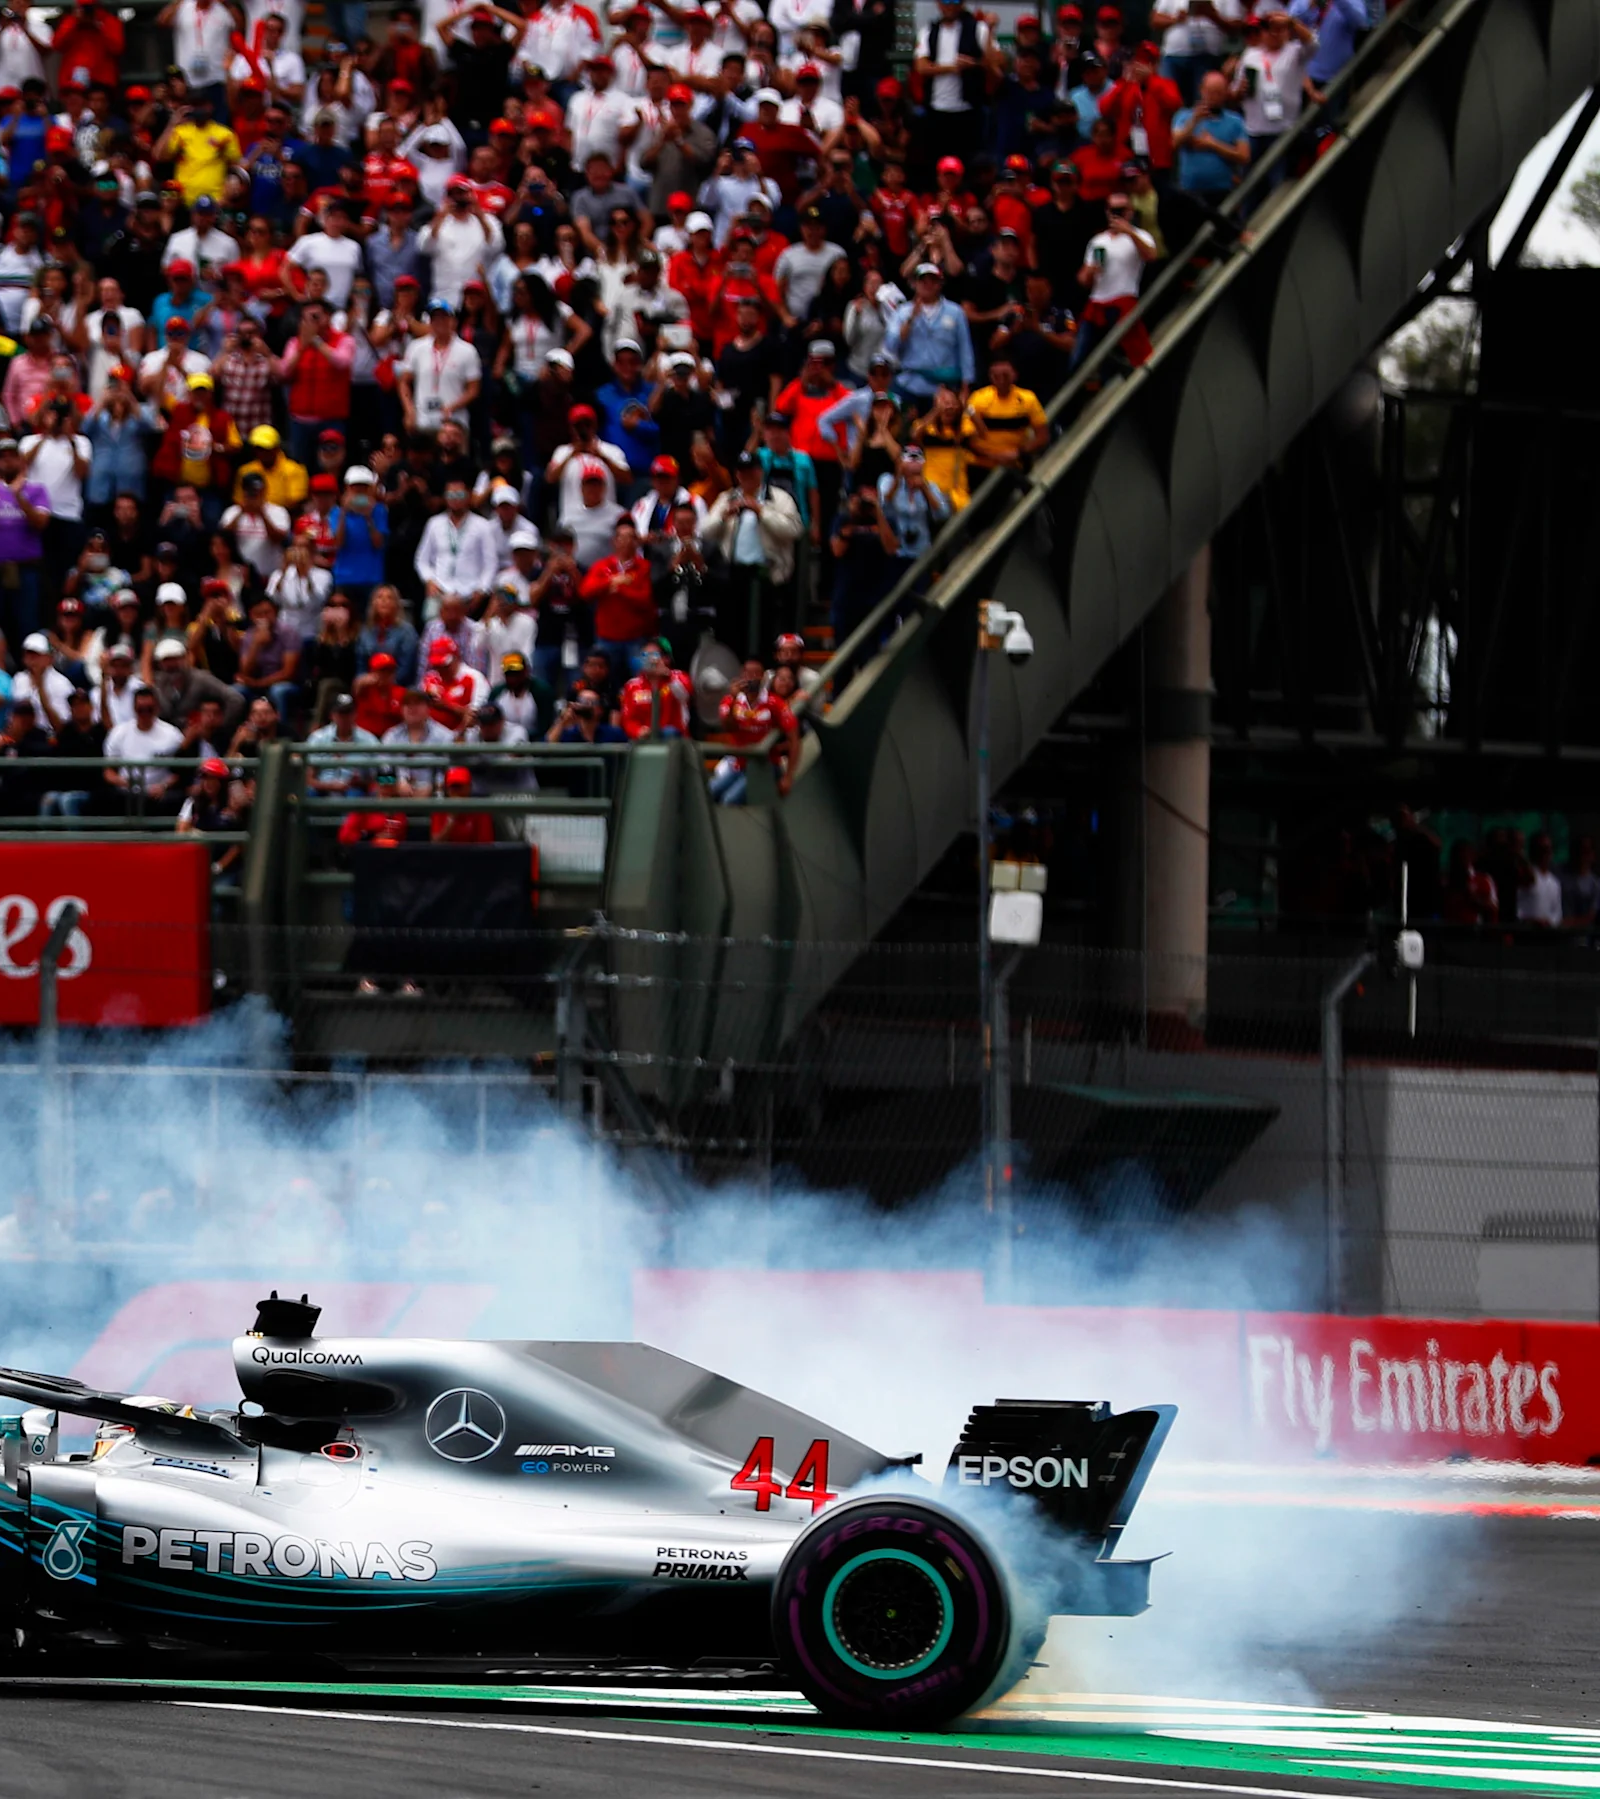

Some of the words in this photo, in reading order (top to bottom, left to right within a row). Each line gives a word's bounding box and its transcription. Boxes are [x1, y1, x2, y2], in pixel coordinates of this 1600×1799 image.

[252, 1347, 364, 1366] Qualcomm
[1248, 1335, 1335, 1451] Fly
[1349, 1338, 1564, 1438] Emirates
[521, 1461, 549, 1474] EQ
[552, 1463, 610, 1474] POWER+
[730, 1437, 838, 1516] 44
[958, 1455, 1089, 1488] EPSON
[122, 1524, 437, 1582] PETRONAS
[657, 1547, 748, 1561] PETRONAS
[816, 1515, 927, 1561] ZERO
[652, 1561, 749, 1581] PRIMAX
